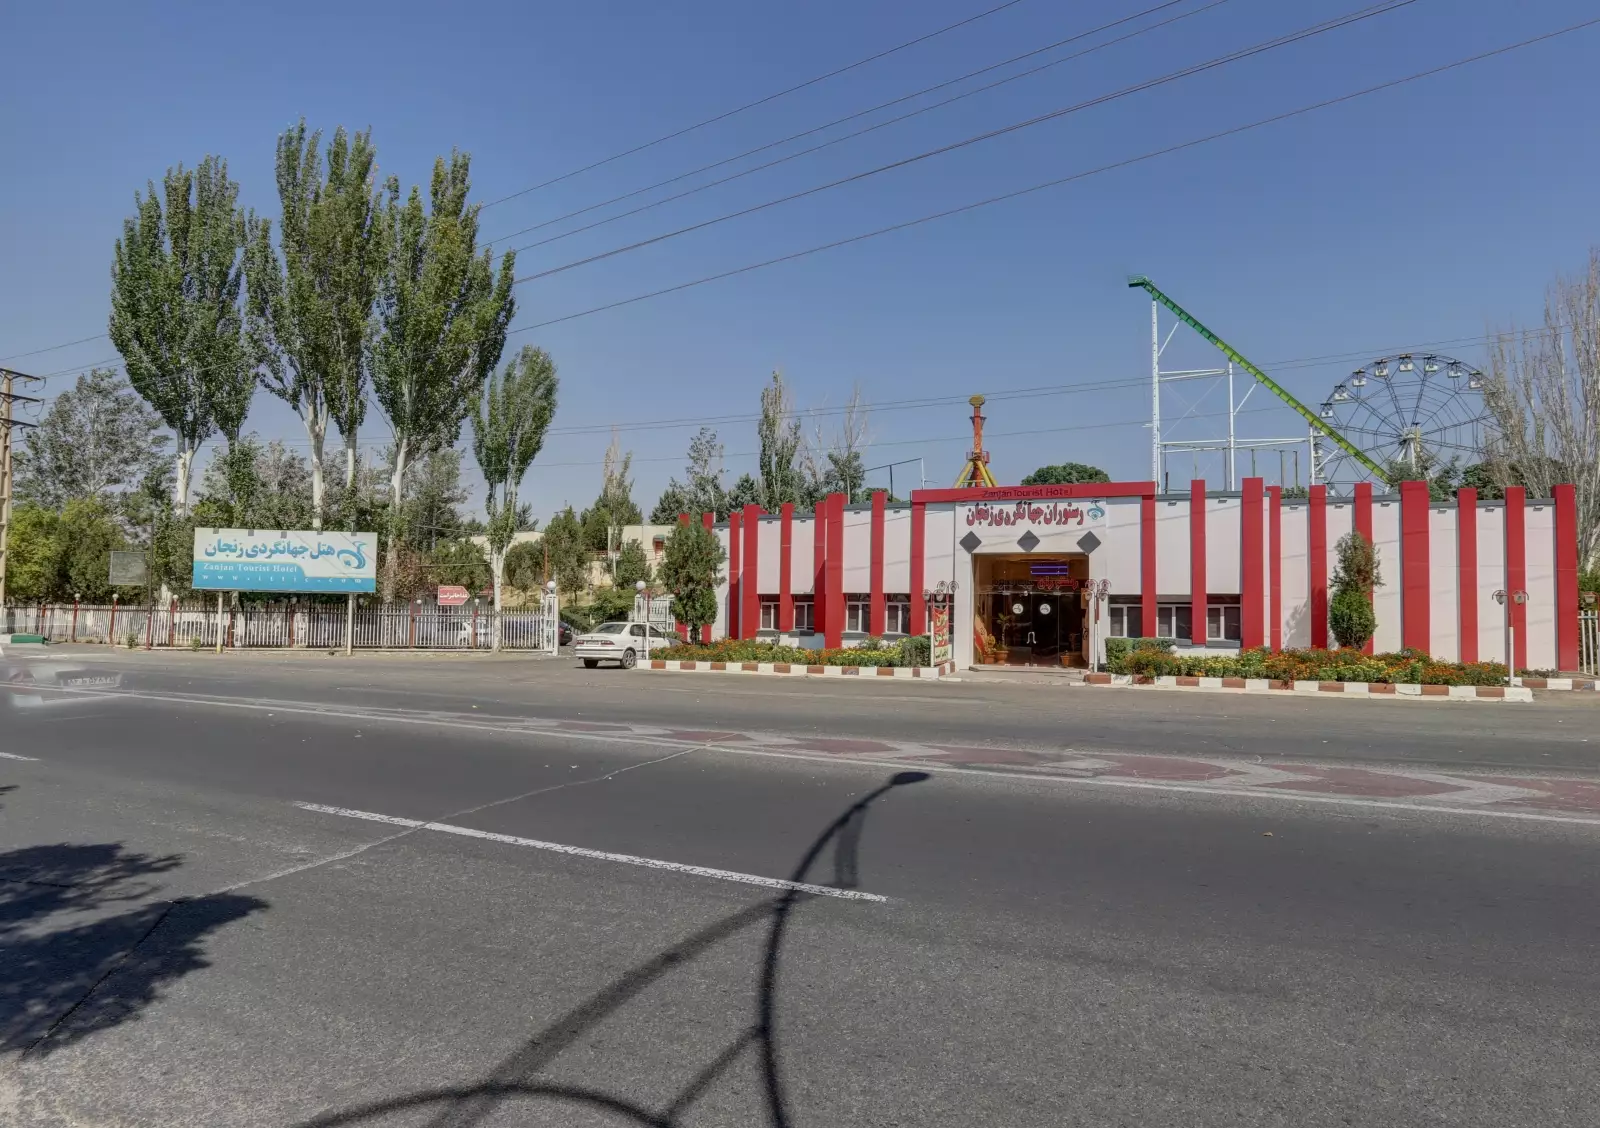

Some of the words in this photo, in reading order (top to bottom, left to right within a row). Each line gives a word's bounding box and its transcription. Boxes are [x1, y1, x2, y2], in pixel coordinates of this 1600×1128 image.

[982, 490, 1012, 499] Zanjan
[1013, 488, 1043, 498] Tourist
[1046, 487, 1073, 496] Hotel
[966, 502, 994, 527] زنجان
[994, 500, 1044, 526] جهانگردی
[1043, 502, 1084, 526] رستوران
[204, 538, 245, 559] زنجان
[245, 540, 310, 560] جهانگردی
[310, 541, 336, 560] هتل
[203, 562, 234, 572] Zanjan
[237, 562, 270, 573] Tourist
[273, 564, 298, 573] Hotel
